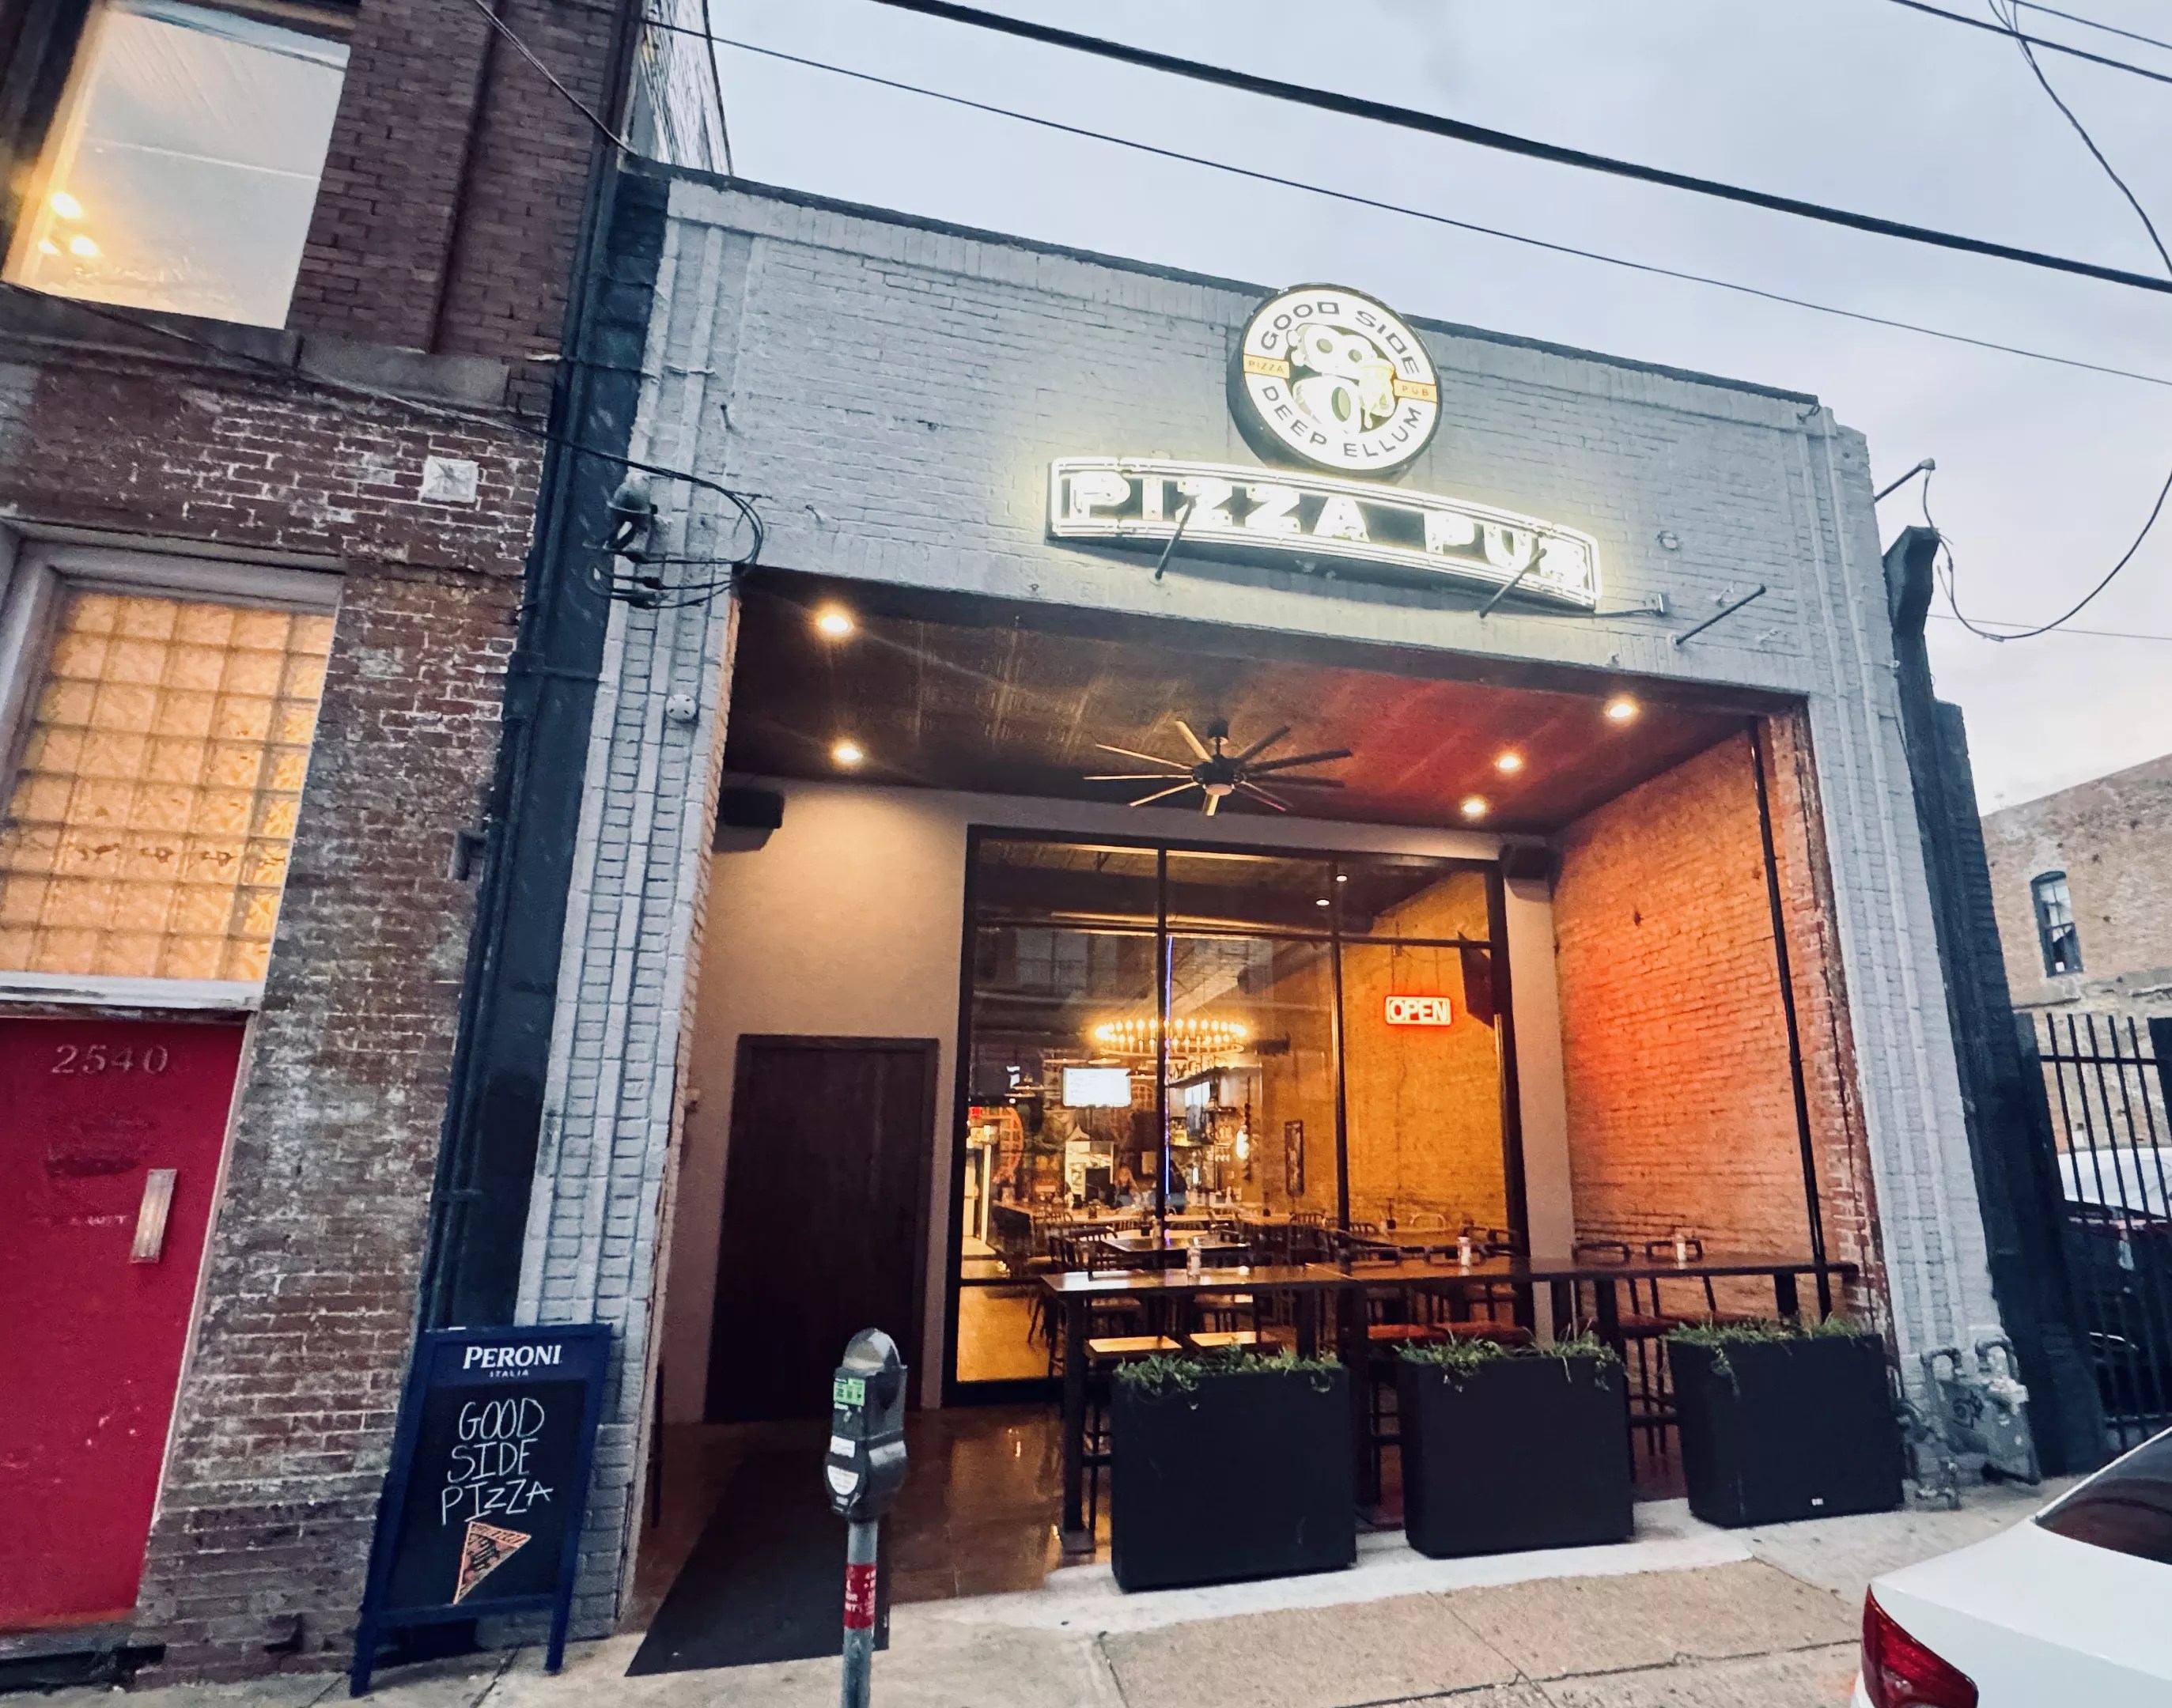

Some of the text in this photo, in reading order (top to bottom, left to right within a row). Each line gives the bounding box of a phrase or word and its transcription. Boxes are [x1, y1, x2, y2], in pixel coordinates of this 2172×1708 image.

[1261, 301, 1420, 375] GOOD SIDE
[1248, 360, 1285, 373] PIZZA
[1402, 385, 1430, 397] PUB
[1262, 385, 1421, 457] DEEP ELLUM
[1069, 471, 1371, 544] PIZZA
[1390, 999, 1447, 1022] OPEN
[50, 1044, 168, 1075] 2540
[463, 1344, 563, 1370] PERONI
[489, 1369, 529, 1378] ITALIA
[459, 1398, 545, 1441] GOOD
[448, 1438, 539, 1483] SIDE
[441, 1478, 554, 1526] PIZZA
